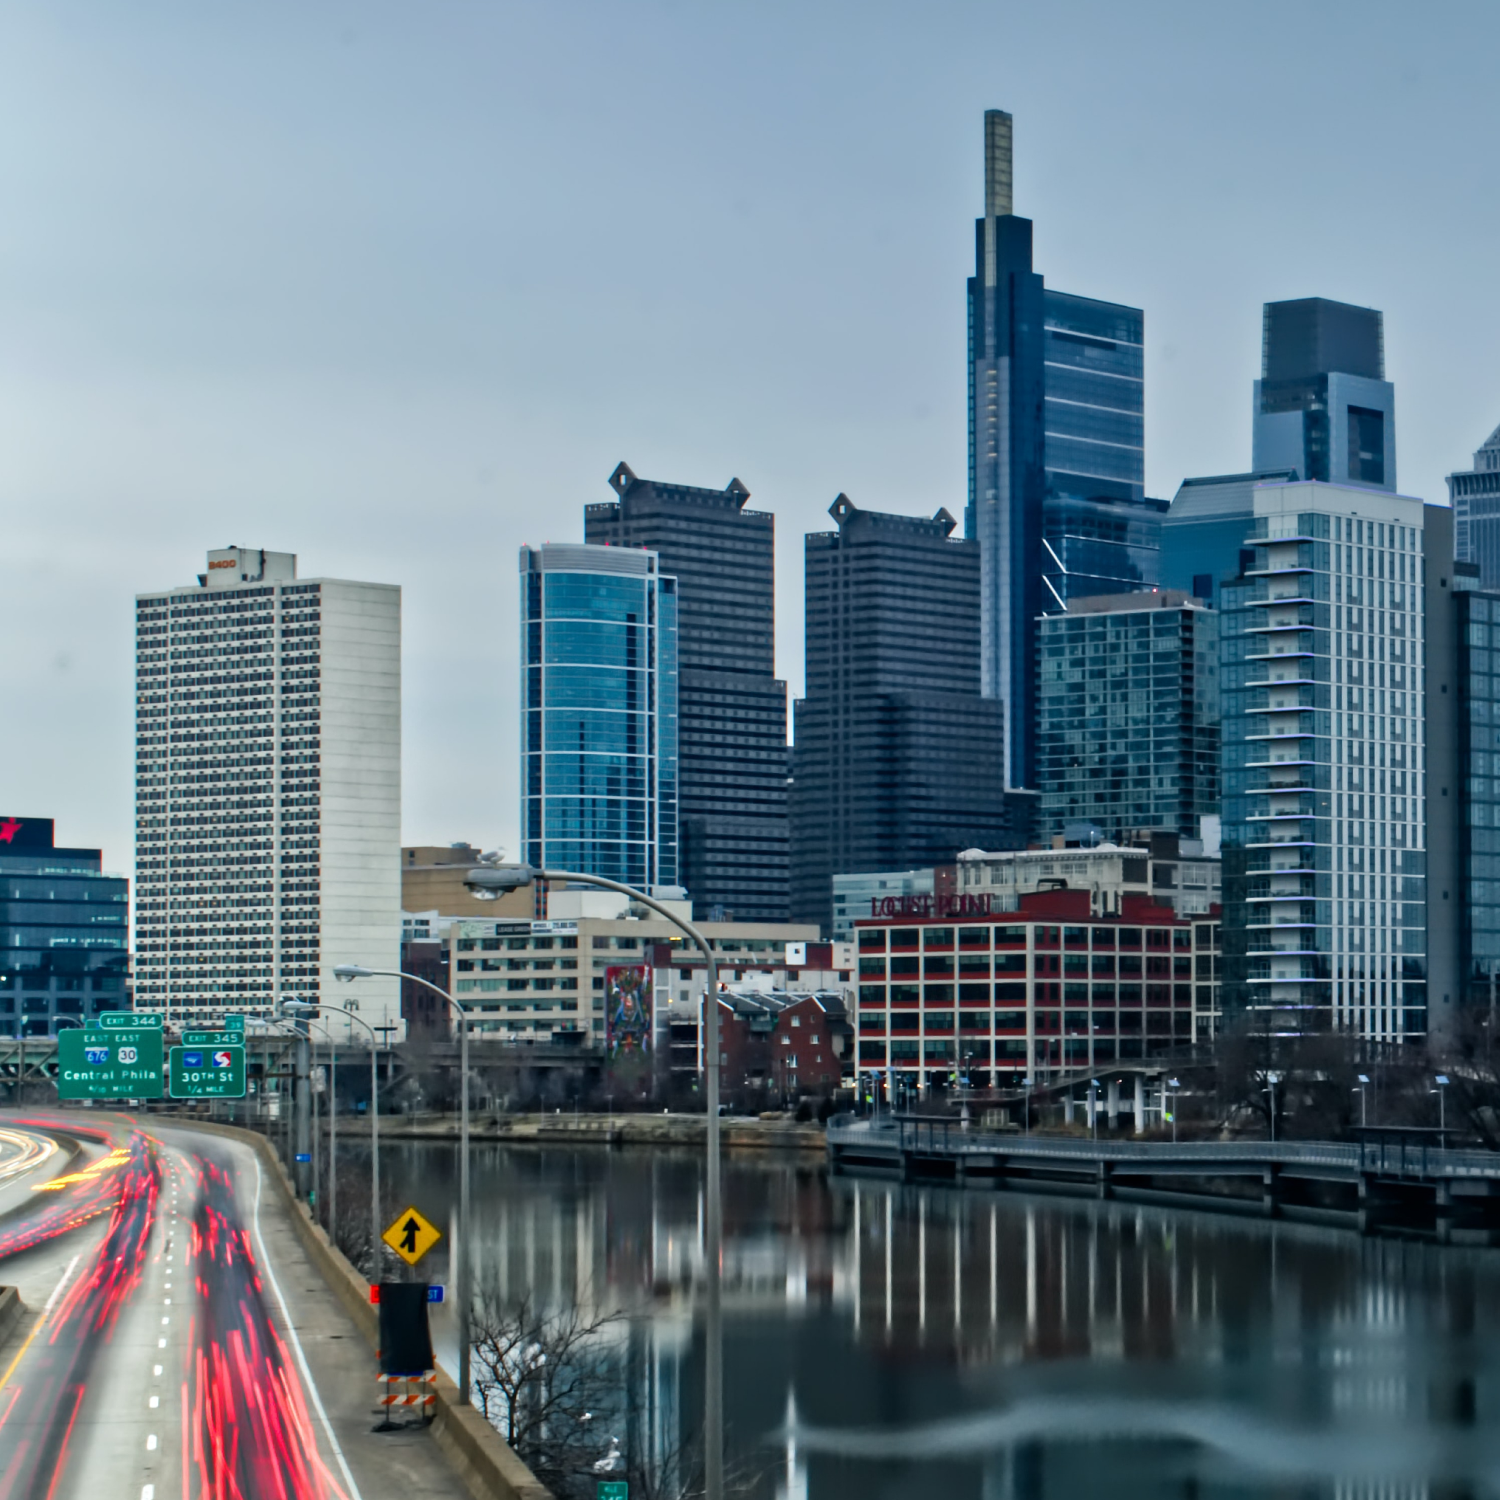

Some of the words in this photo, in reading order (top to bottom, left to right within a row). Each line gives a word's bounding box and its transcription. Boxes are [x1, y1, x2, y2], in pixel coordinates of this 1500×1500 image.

[935, 893, 996, 917] POINT
[106, 1017, 125, 1025] EXIT
[131, 1016, 156, 1026] 344
[84, 1034, 109, 1042] EAST
[115, 1034, 140, 1042] EAST
[213, 1033, 238, 1043] 345
[87, 1051, 107, 1062] 676
[120, 1049, 136, 1060] 30
[64, 1070, 114, 1080] Central
[181, 1072, 215, 1082] 30TH
[219, 1072, 233, 1082] St
[187, 1085, 202, 1094] 1/4
[206, 1085, 224, 1093] MILE
